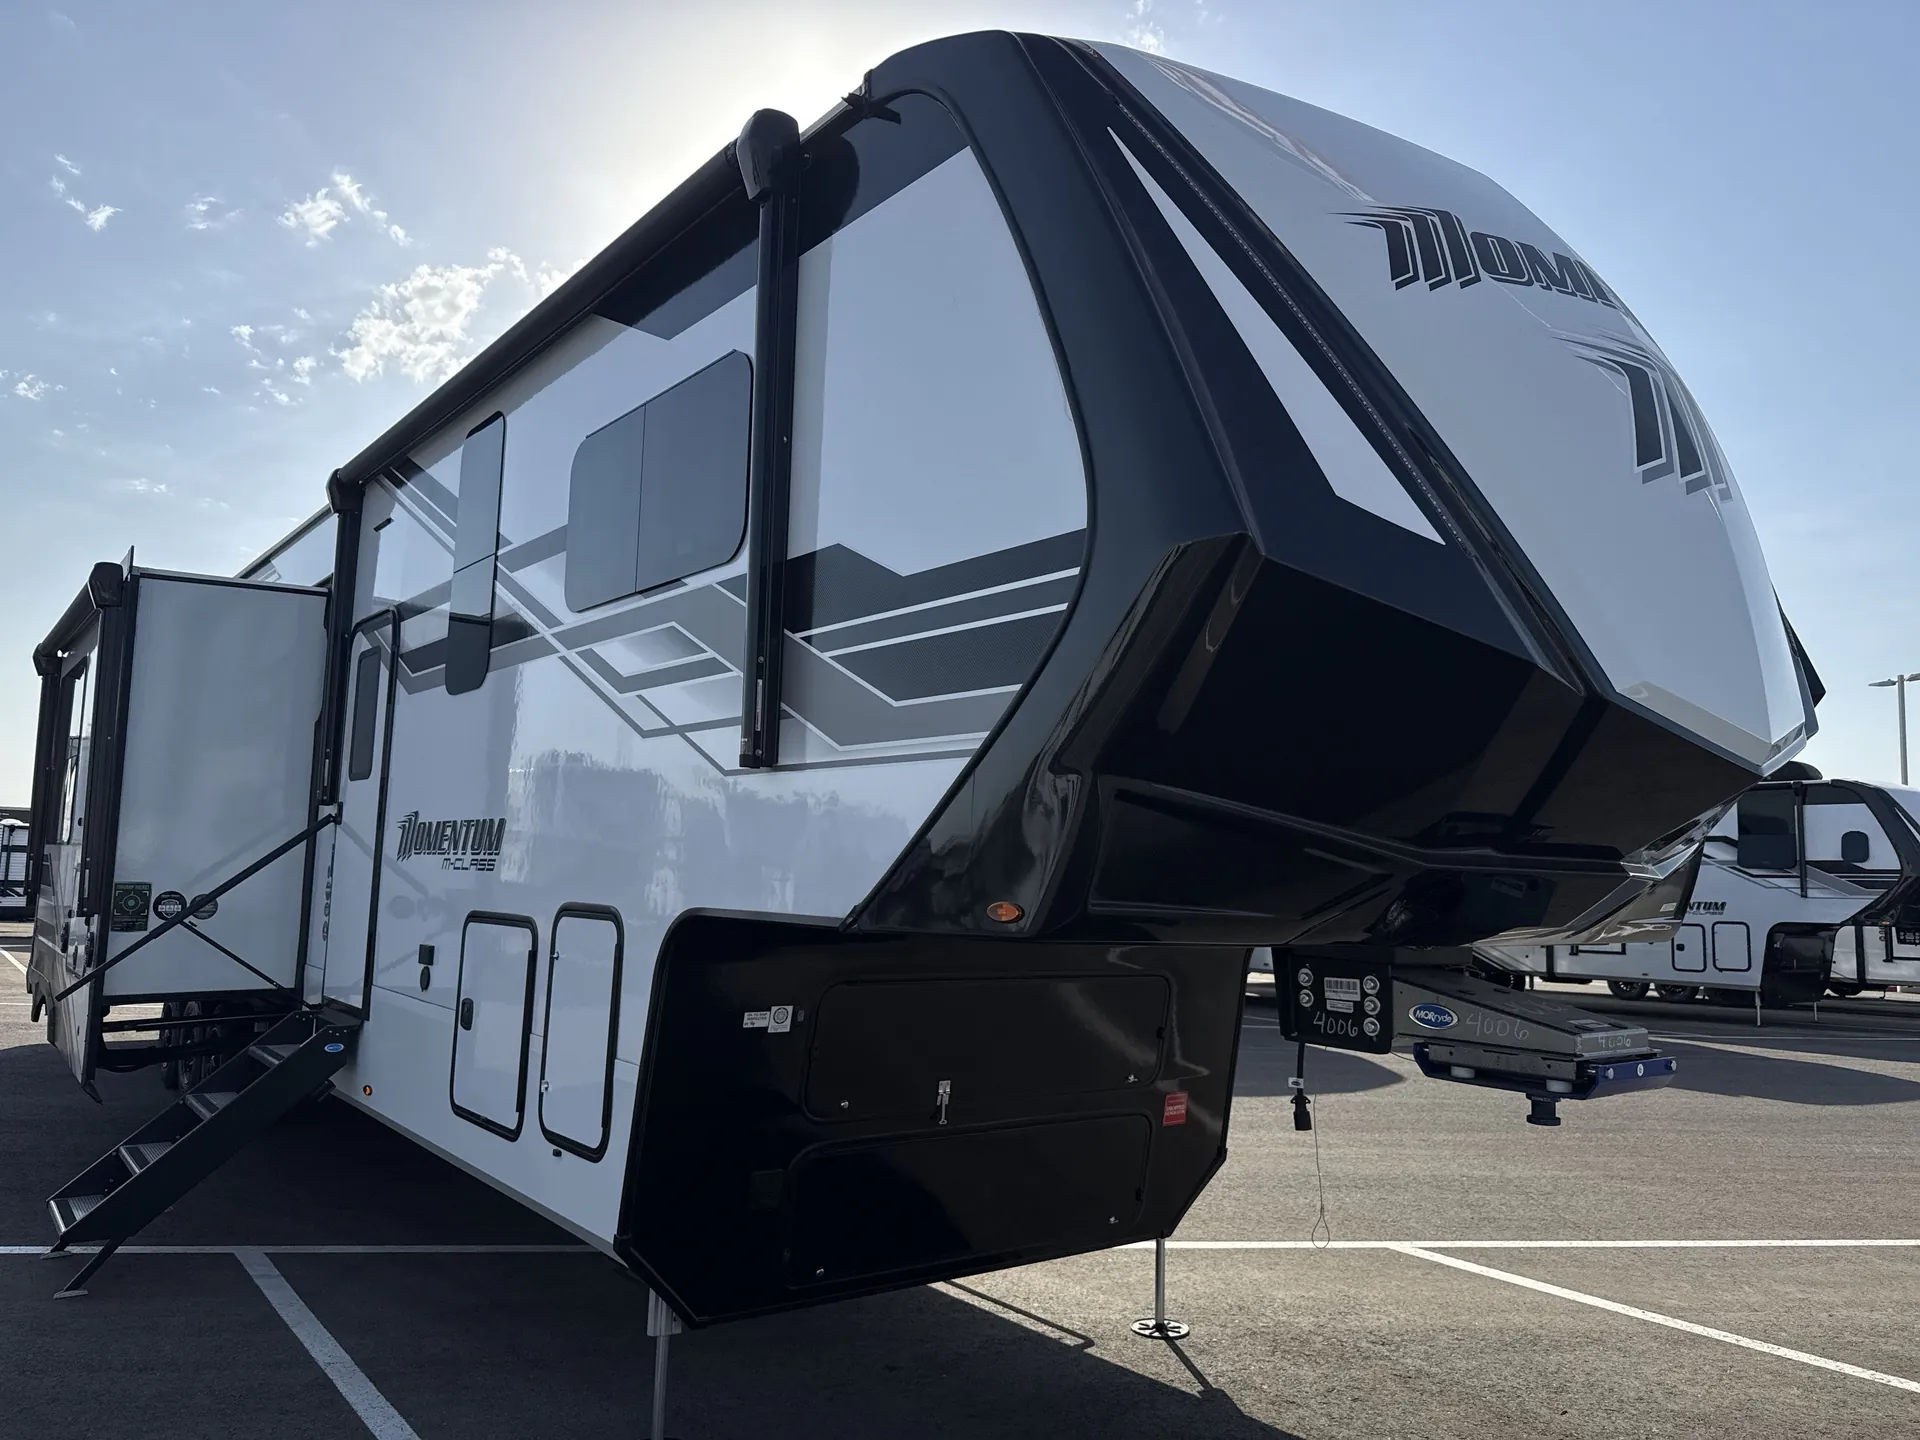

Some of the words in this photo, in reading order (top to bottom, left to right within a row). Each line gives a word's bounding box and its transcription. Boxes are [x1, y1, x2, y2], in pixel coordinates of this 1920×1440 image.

[396, 810, 507, 862] MOMENTUM
[441, 858, 497, 872] M-CLASS
[1313, 1010, 1359, 1037] 4006
[1415, 1008, 1453, 1023] MORryde
[1466, 1011, 1529, 1040] 4006
[1598, 1034, 1632, 1048] 4006
